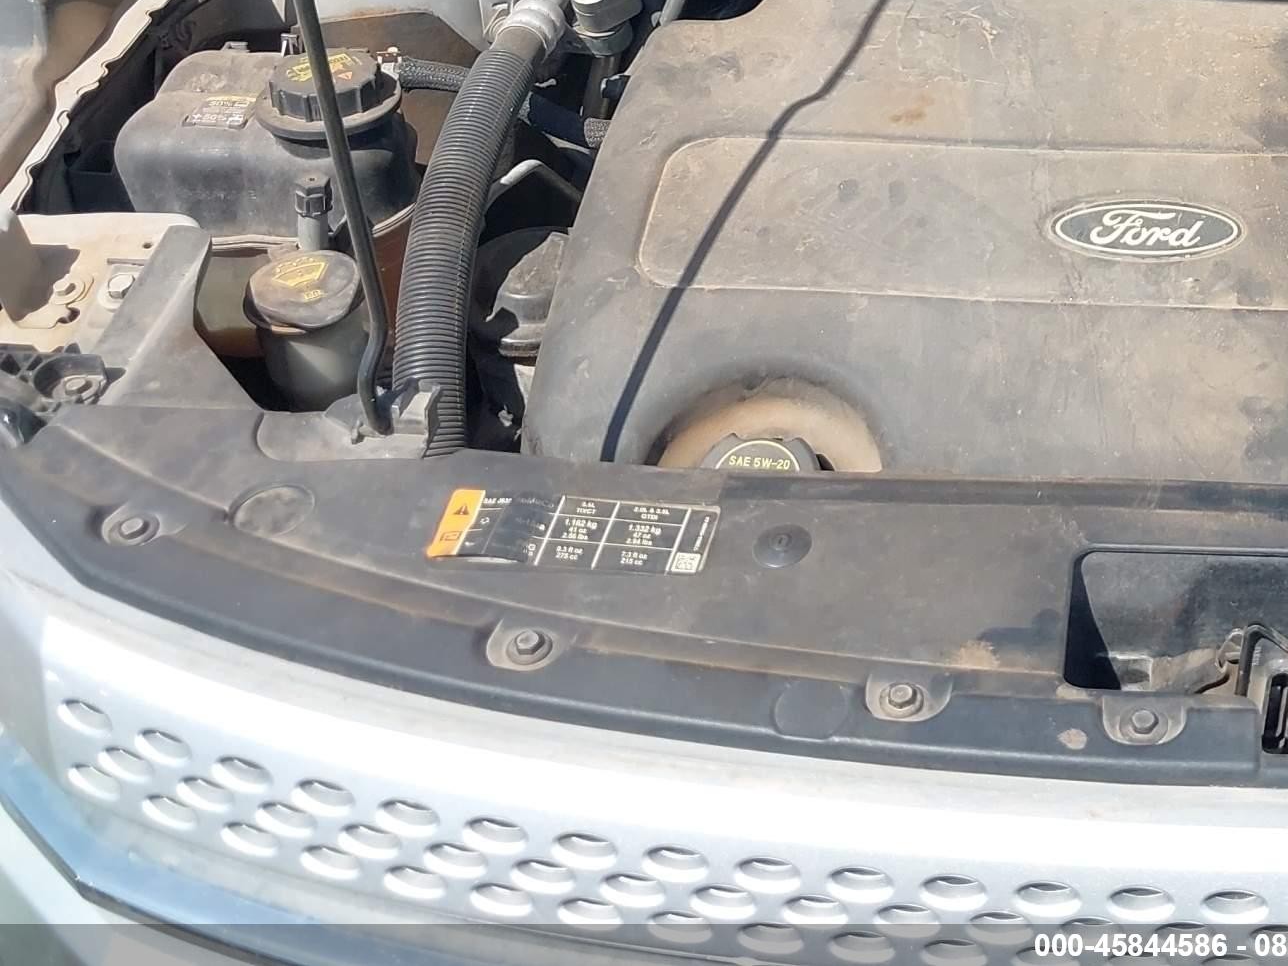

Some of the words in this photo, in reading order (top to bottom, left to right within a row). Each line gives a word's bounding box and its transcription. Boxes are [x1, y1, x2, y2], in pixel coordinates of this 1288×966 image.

[1090, 209, 1204, 247] Ford
[728, 455, 751, 467] SAE
[753, 457, 790, 470] 5W-20
